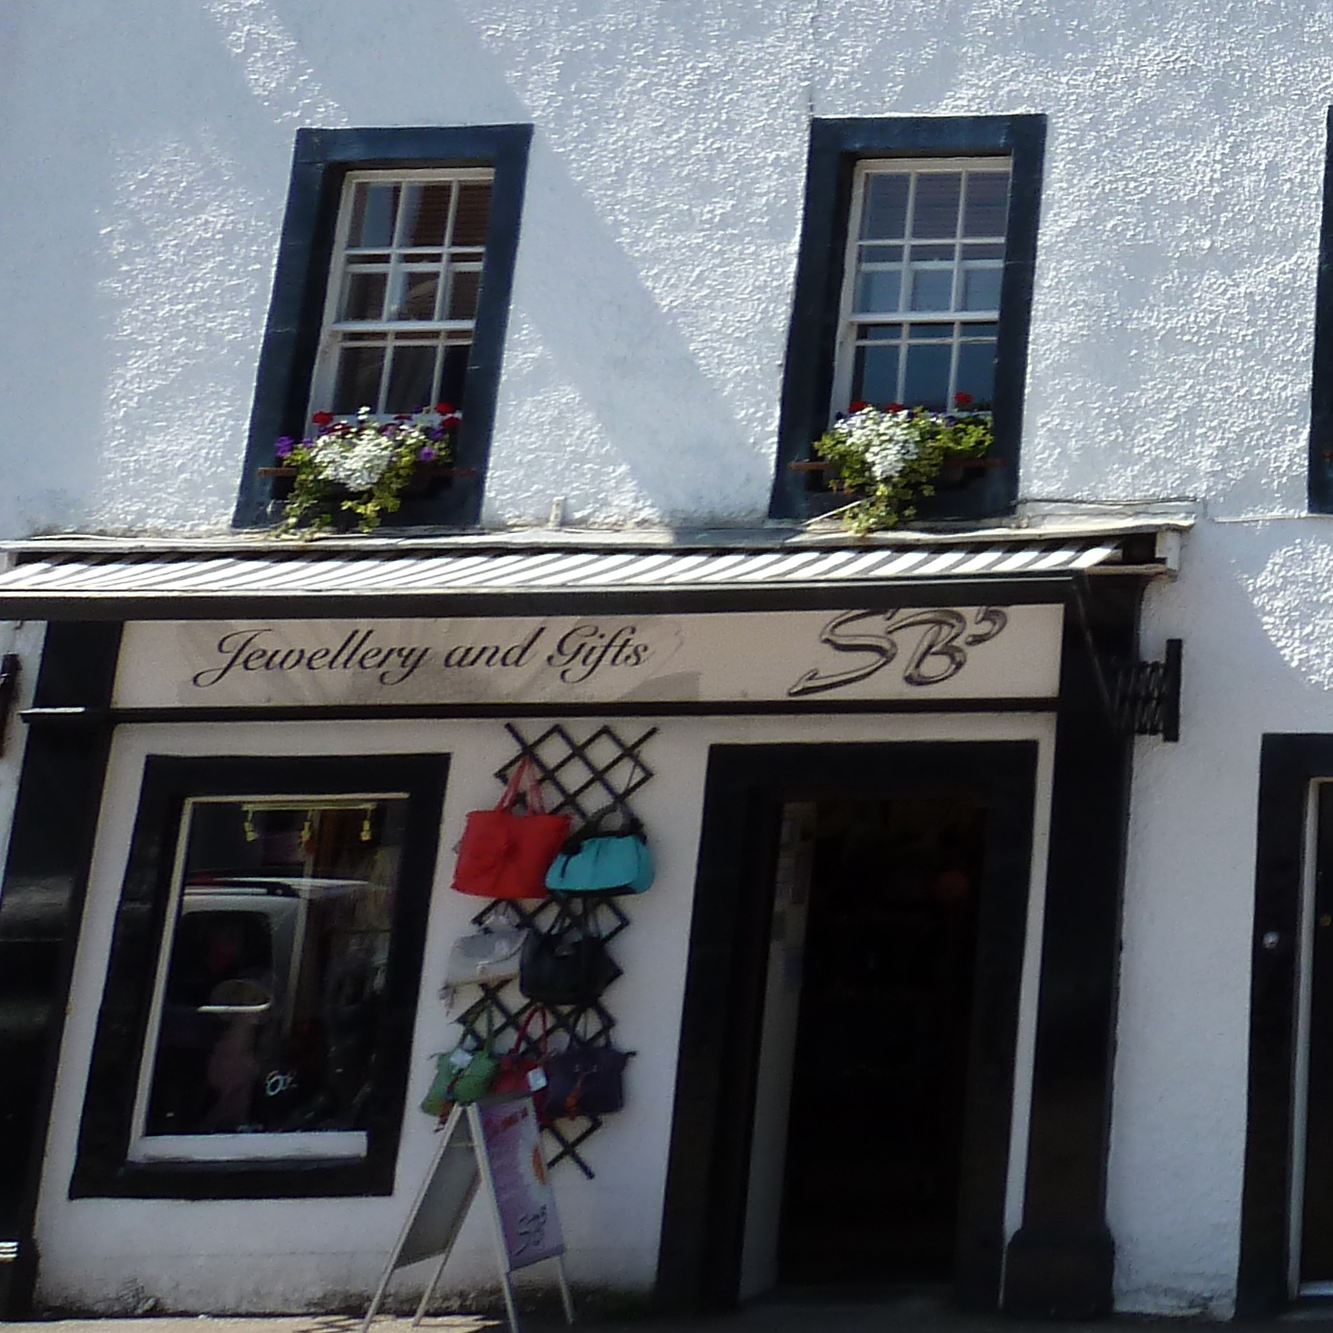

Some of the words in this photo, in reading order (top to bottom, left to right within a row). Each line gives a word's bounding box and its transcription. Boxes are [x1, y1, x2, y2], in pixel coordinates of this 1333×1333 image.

[192, 628, 427, 687] Jewellery
[444, 626, 544, 669] and
[545, 625, 650, 683] Gifts
